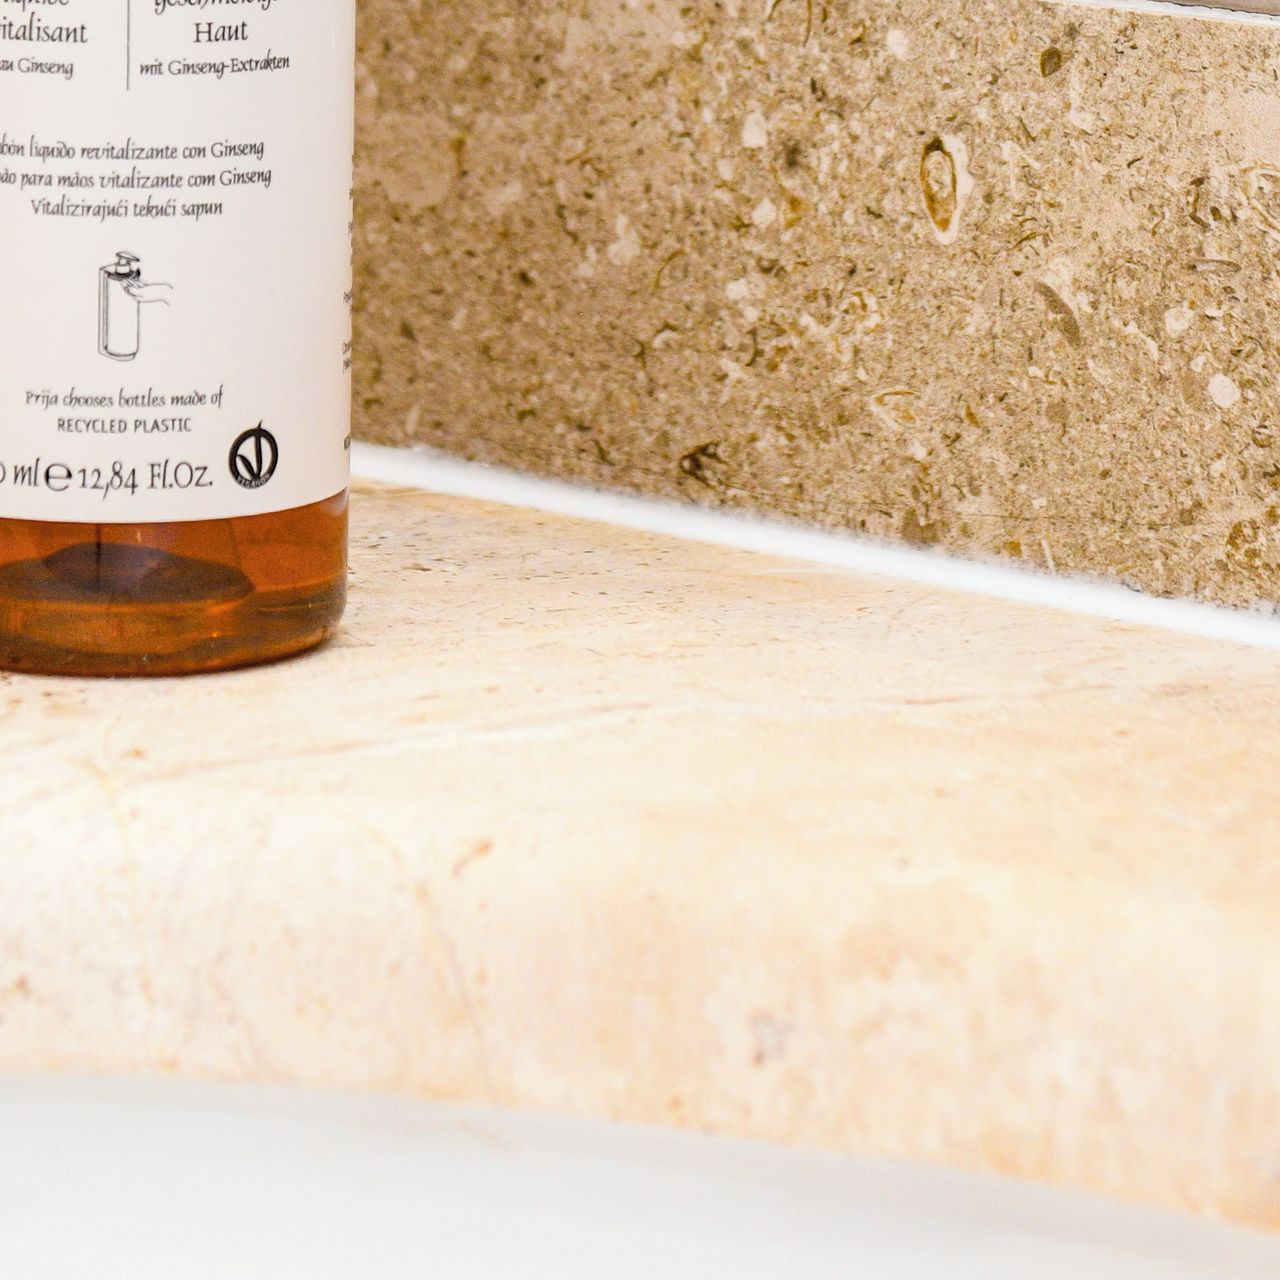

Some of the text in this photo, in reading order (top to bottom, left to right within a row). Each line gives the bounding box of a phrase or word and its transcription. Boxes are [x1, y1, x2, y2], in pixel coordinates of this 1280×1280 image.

[193, 21, 248, 43] Haut
[17, 57, 73, 80] Ginseng
[140, 48, 289, 80] mit Ginseng-Extrakten
[81, 137, 177, 160] revitalizante
[183, 146, 206, 159] con
[211, 139, 264, 160] Ginseng
[21, 174, 53, 190] para
[99, 166, 183, 188] vitalizante
[187, 174, 215, 187] com
[219, 167, 271, 188] Ginseng
[180, 202, 223, 221] sapun
[26, 384, 223, 410] Prija chooses bottles made of
[58, 418, 191, 433] RECYCLED PLASTIC
[13, 457, 40, 487] ml
[77, 461, 138, 501] 12,84
